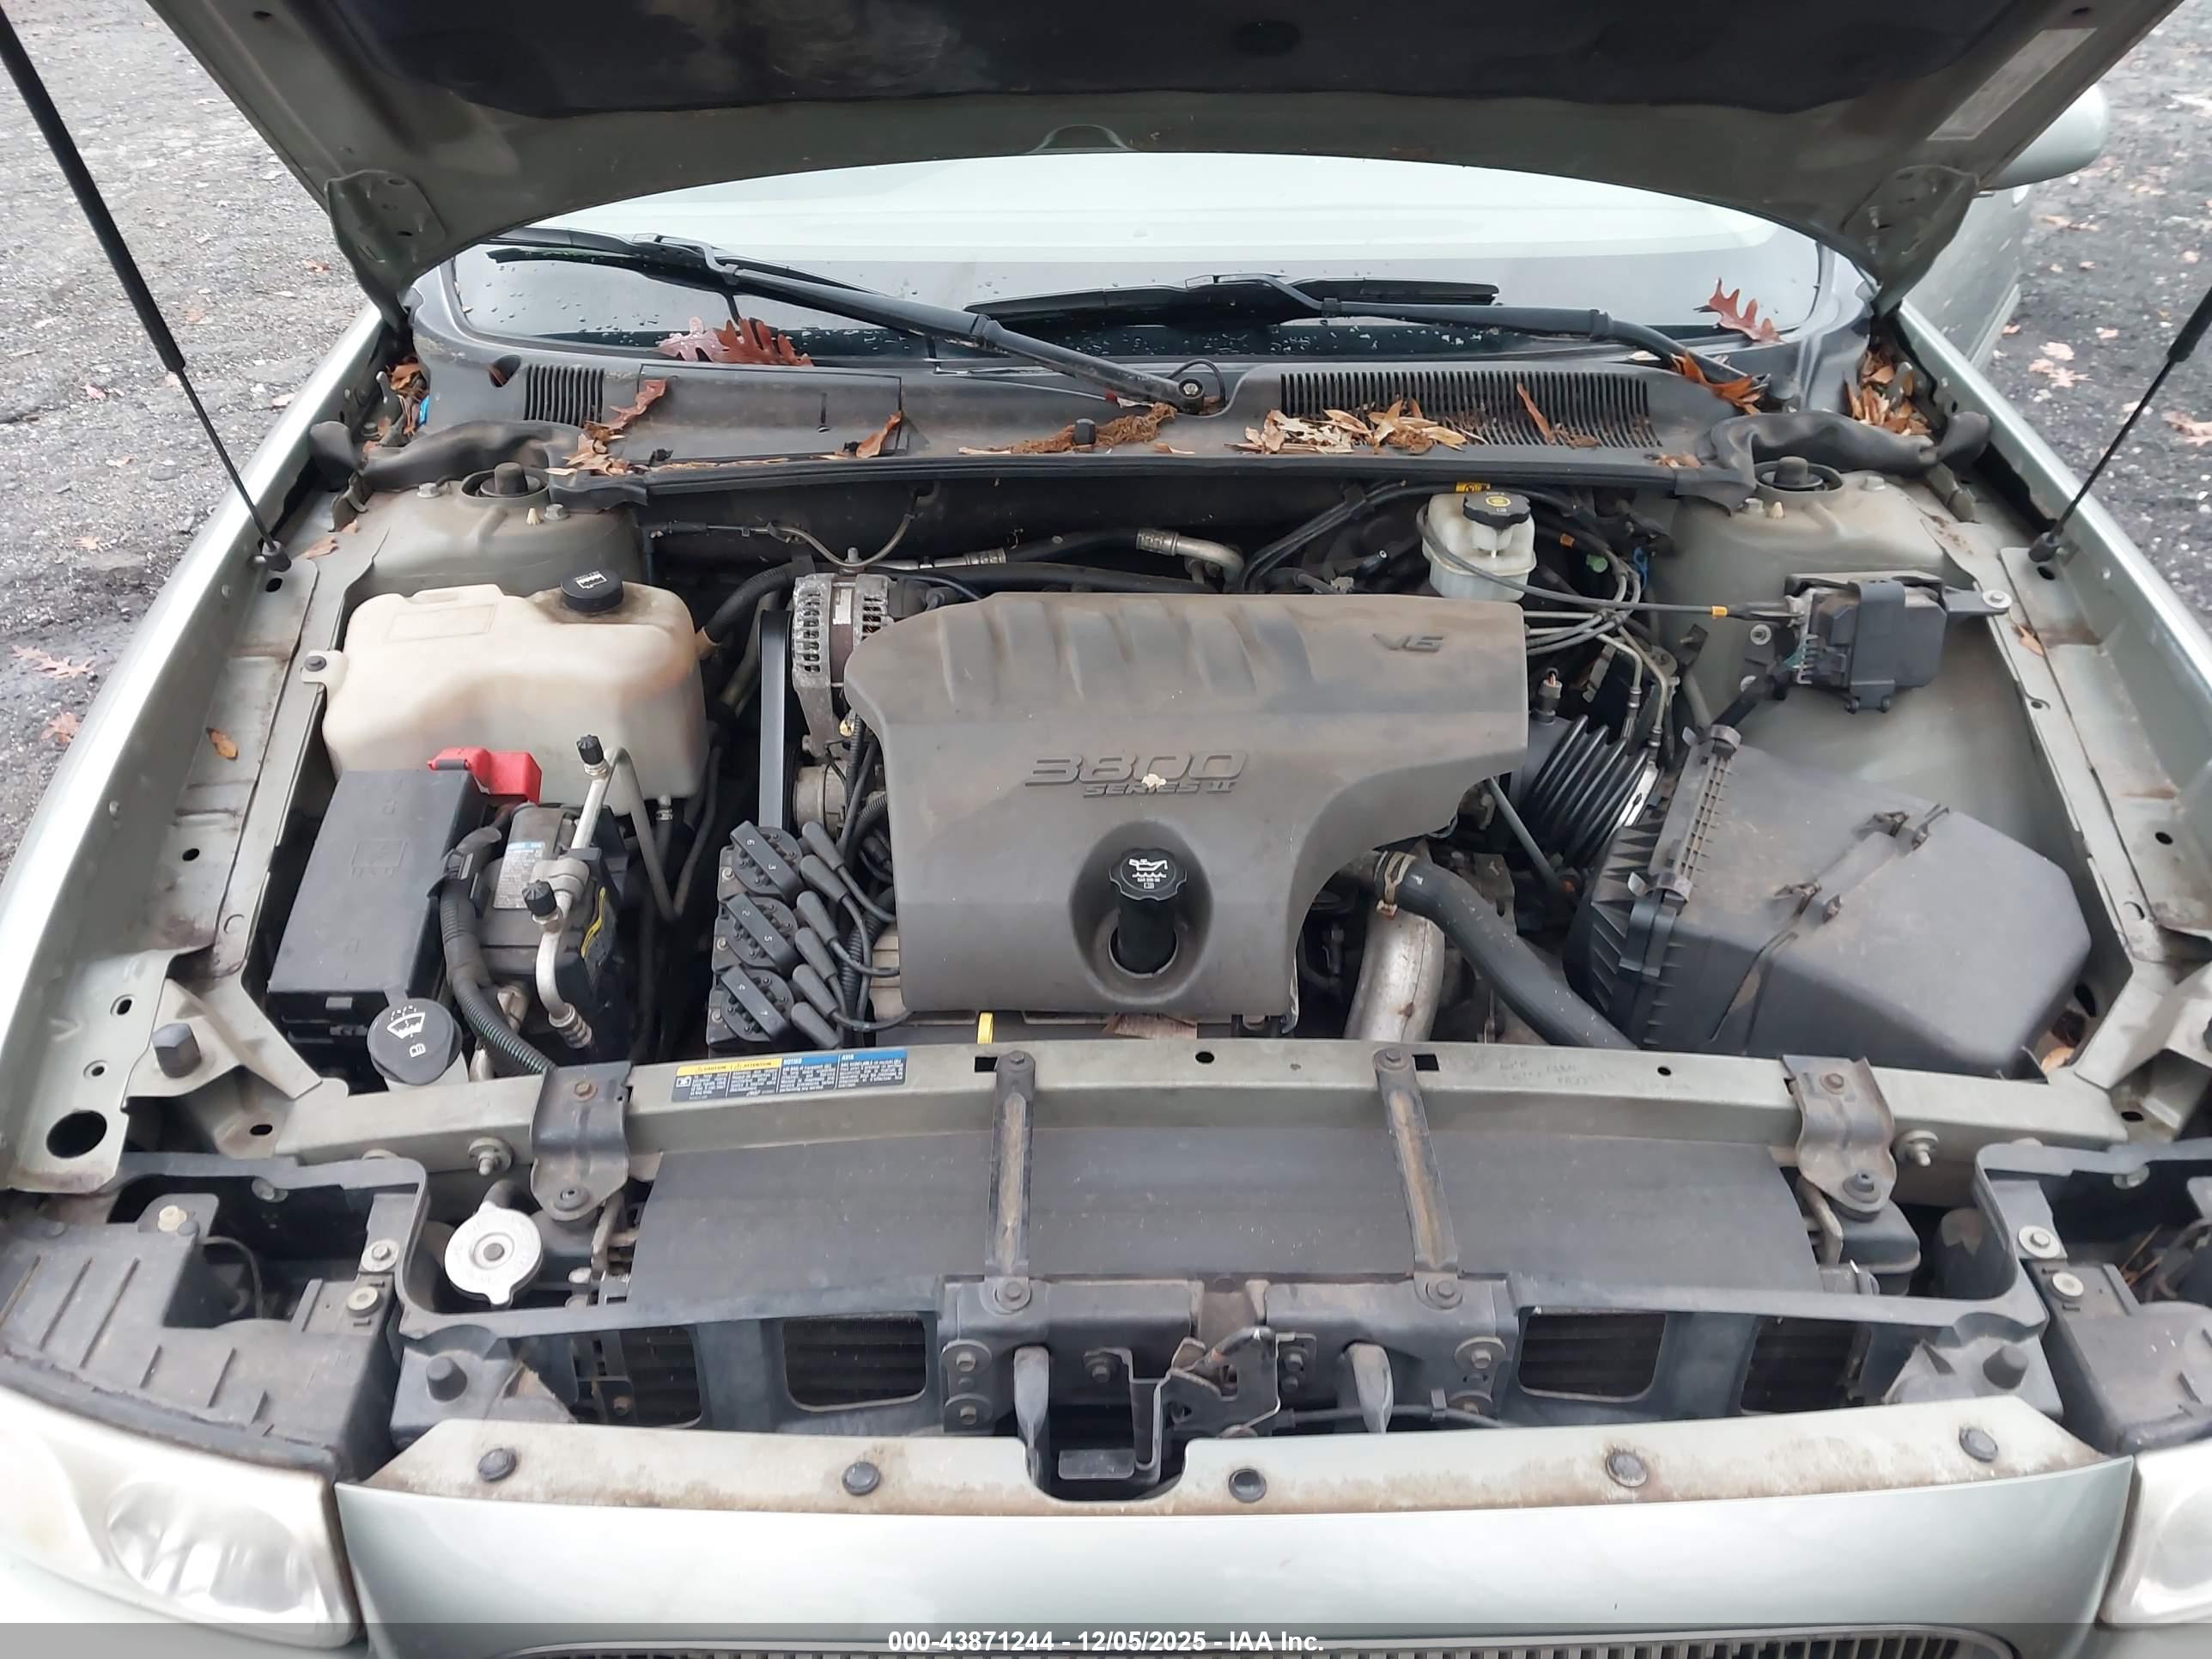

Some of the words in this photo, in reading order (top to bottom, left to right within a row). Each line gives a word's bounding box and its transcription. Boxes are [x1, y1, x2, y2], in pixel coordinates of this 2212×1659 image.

[1373, 631, 1445, 653] V6
[1025, 753, 1247, 787] 3800
[1084, 781, 1200, 798] SERIES
[1206, 781, 1237, 794] II
